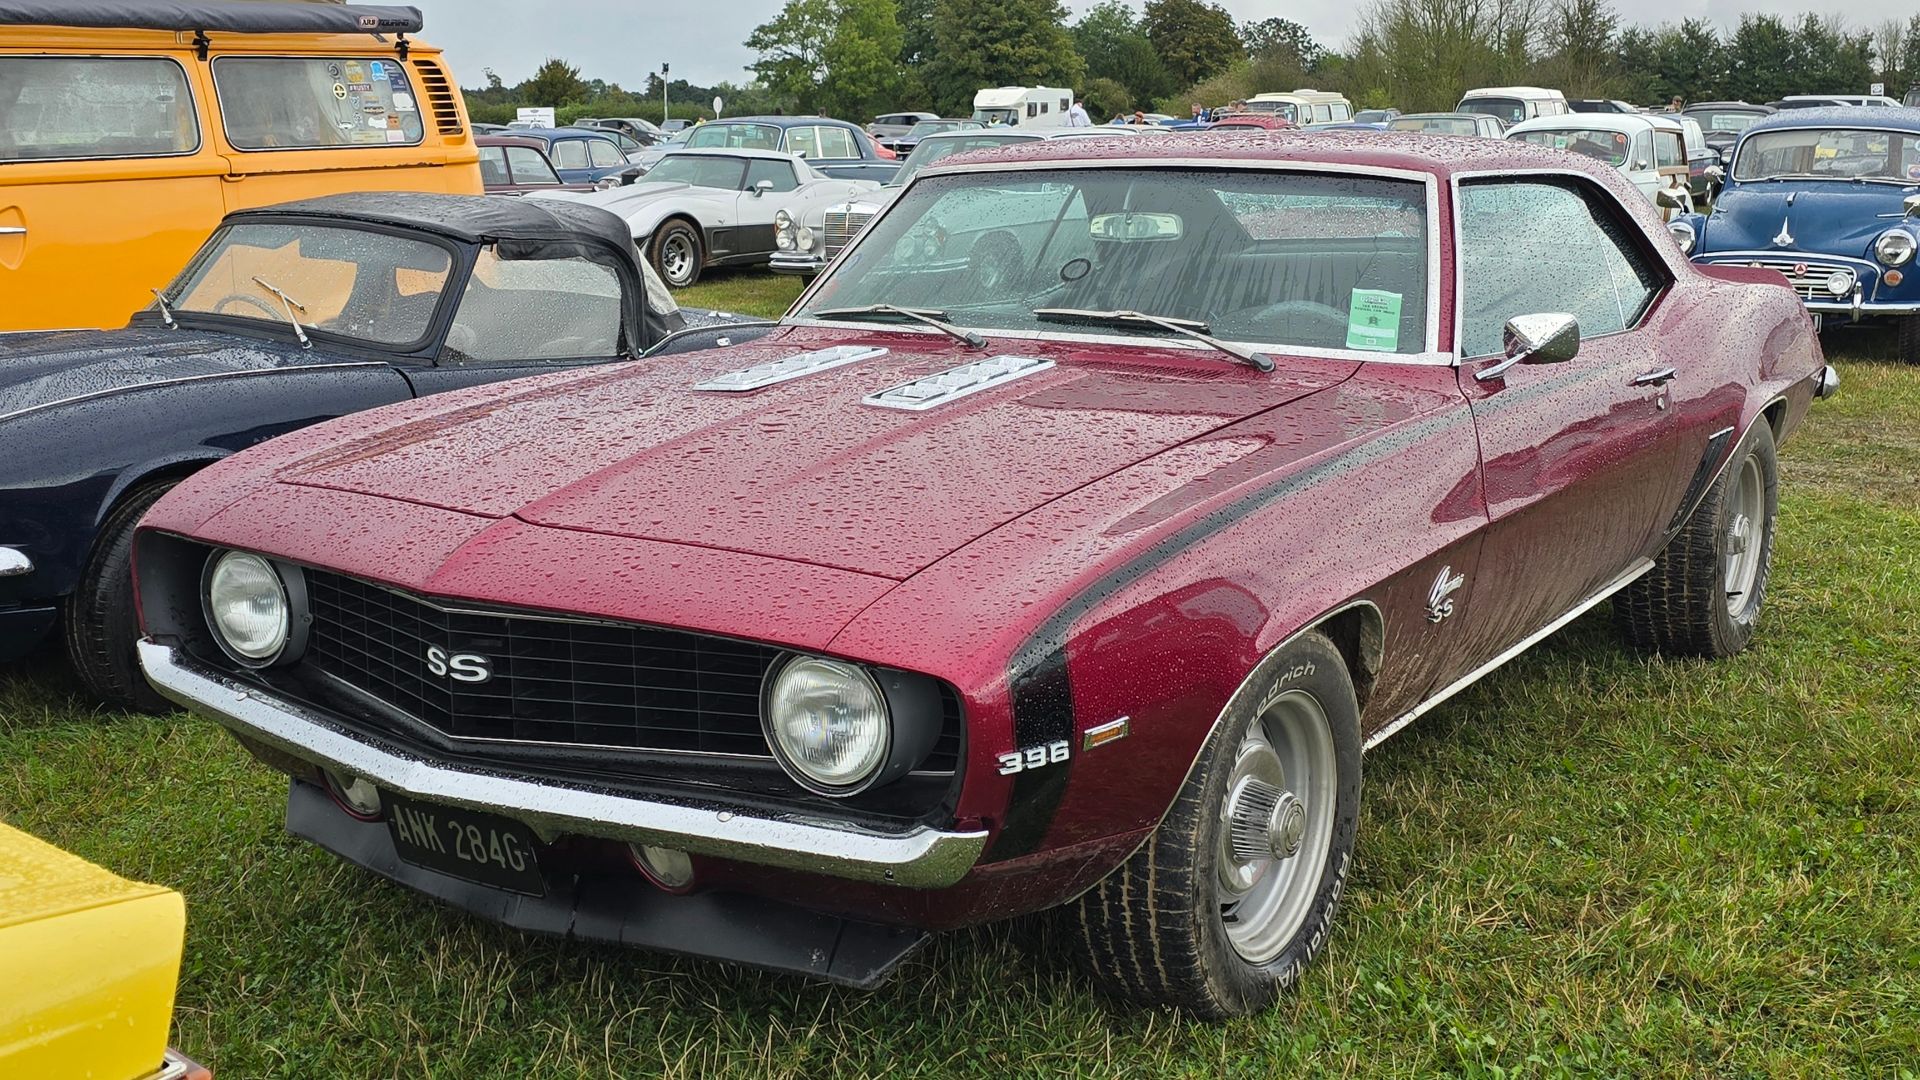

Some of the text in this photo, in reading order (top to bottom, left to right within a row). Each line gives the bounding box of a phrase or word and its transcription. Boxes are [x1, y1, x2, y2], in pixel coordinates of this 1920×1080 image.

[1427, 598, 1454, 623] SS
[427, 646, 488, 682] SS
[998, 740, 1070, 776] 396
[393, 804, 526, 872] ANK 284G
[1306, 851, 1350, 962] Radial
